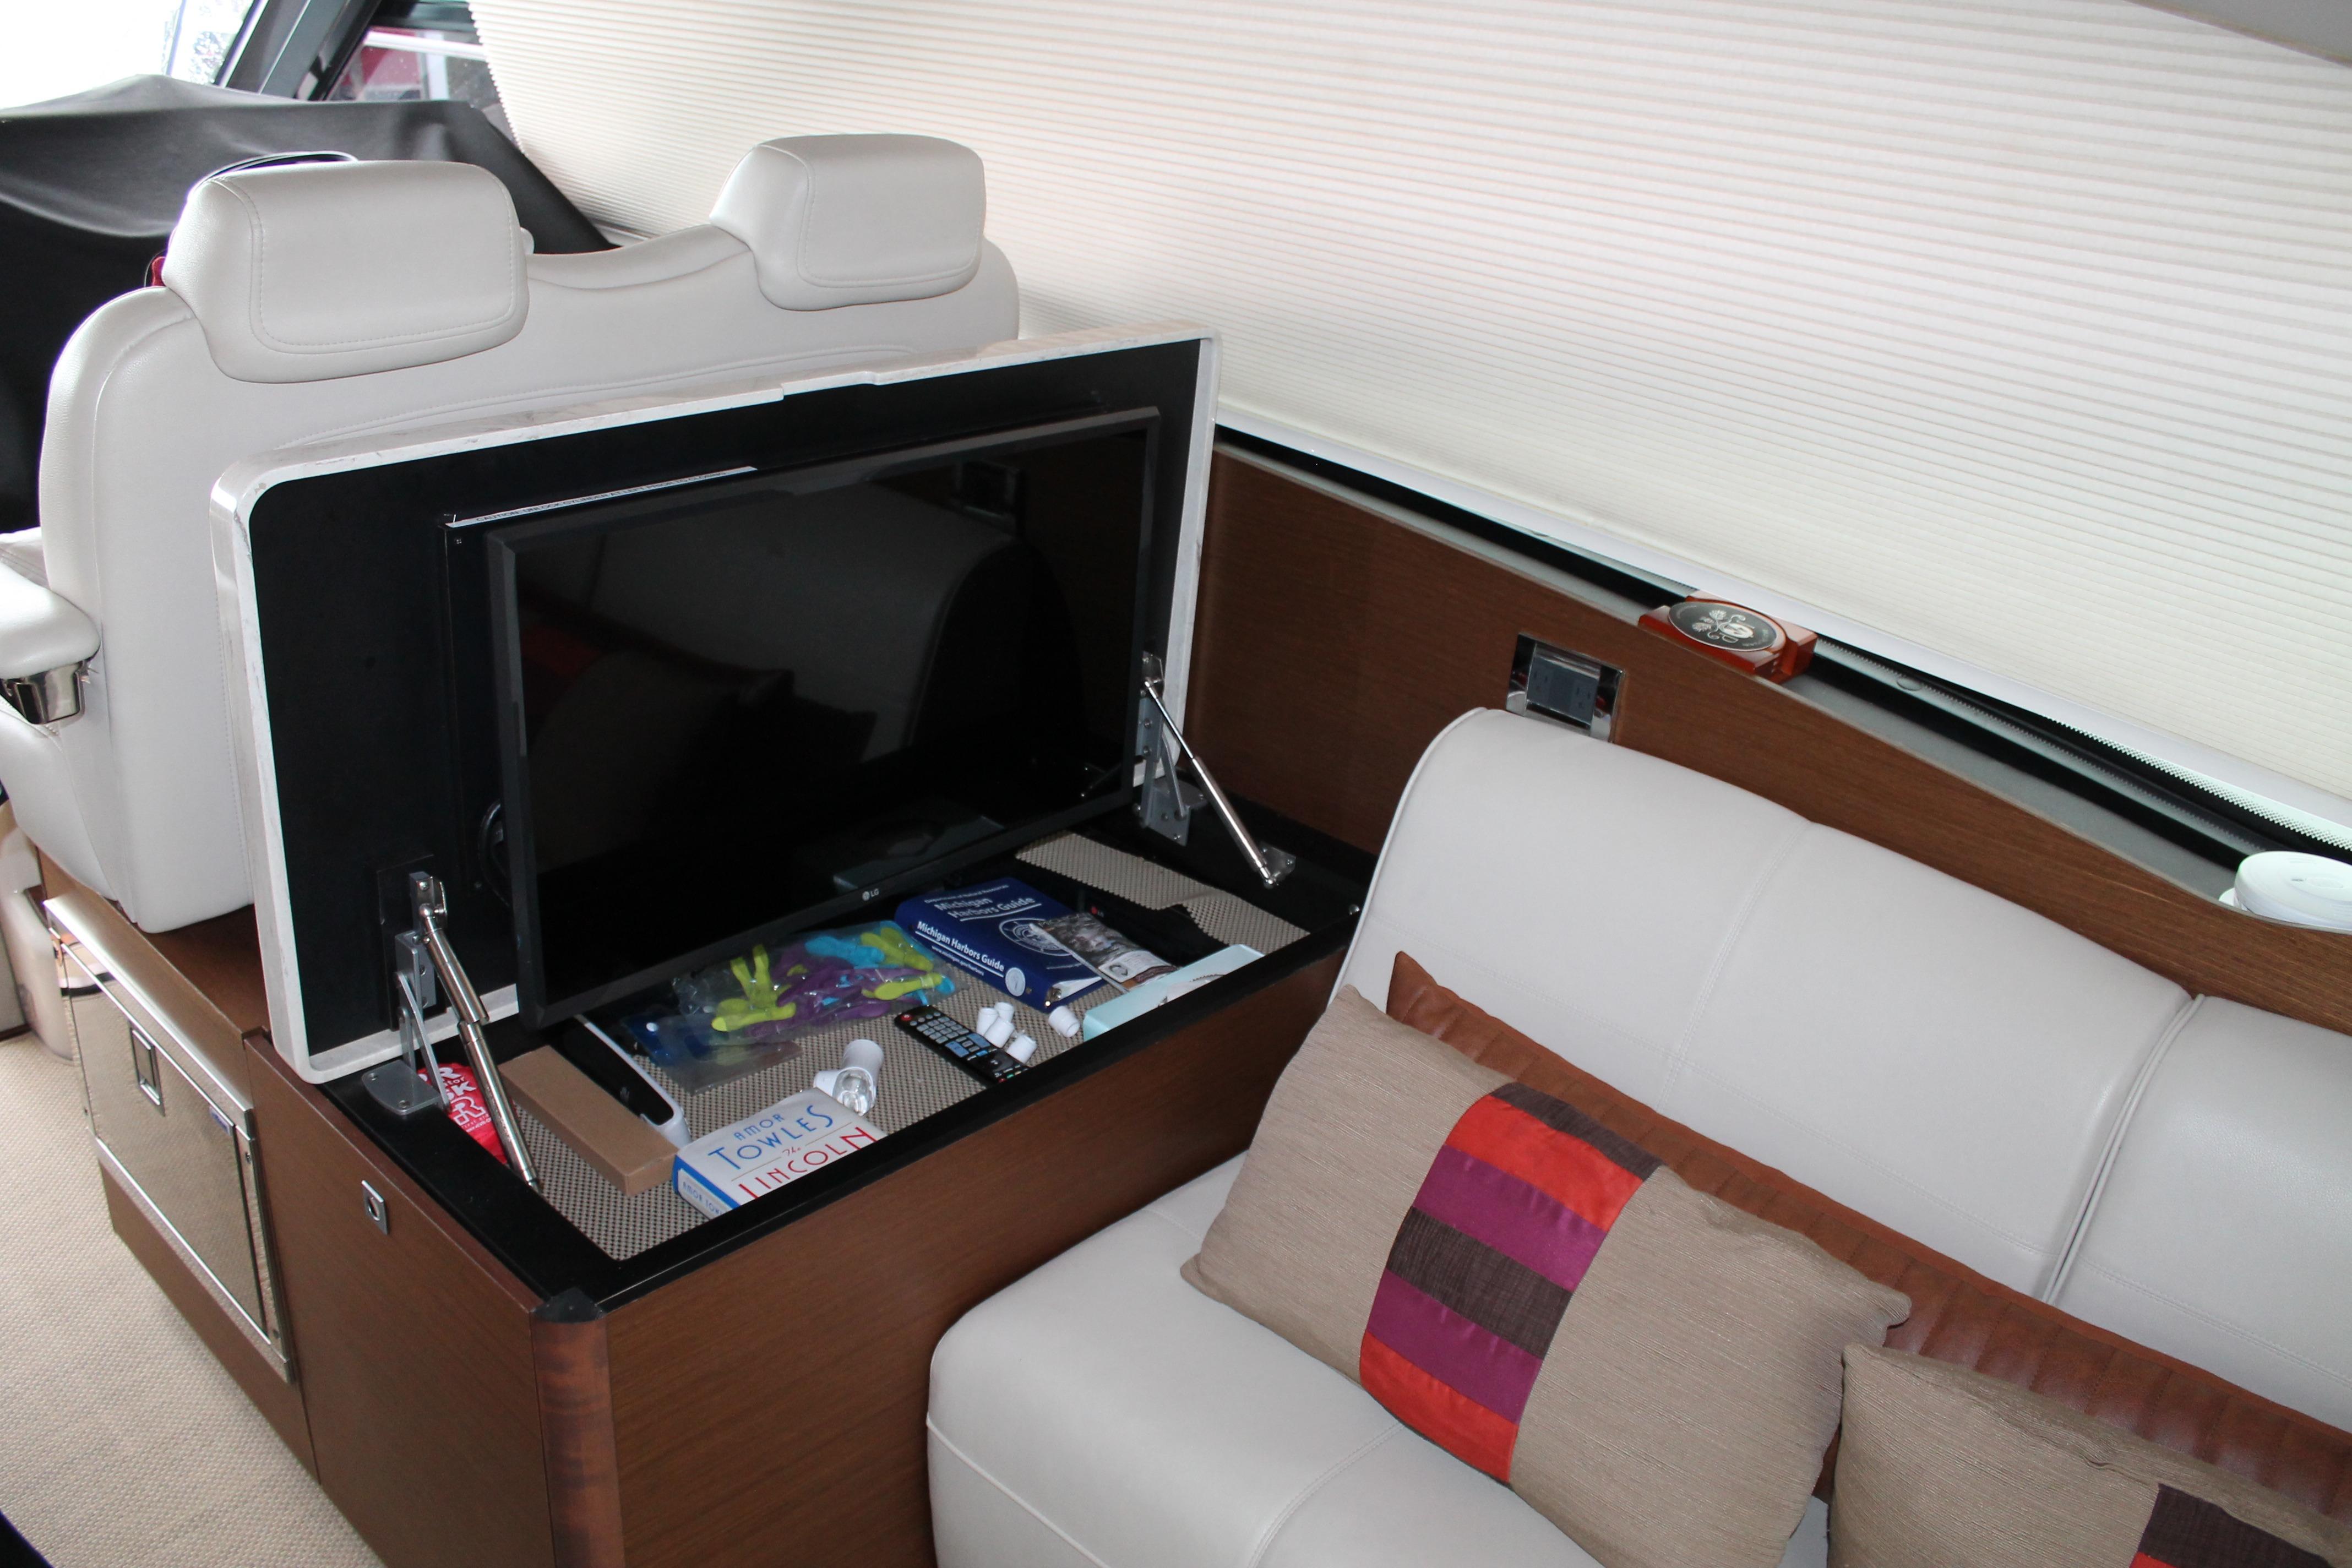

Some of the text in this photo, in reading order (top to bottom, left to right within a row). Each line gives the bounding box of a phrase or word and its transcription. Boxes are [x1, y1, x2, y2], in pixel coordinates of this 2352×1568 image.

[870, 888, 879, 897] LG
[934, 897, 993, 910] Michigan
[948, 897, 1036, 918] Harbors Guide
[917, 921, 1005, 972] Michigan Harbors Guide
[708, 1105, 833, 1170] TOWLES
[734, 1113, 785, 1141] AMOR
[738, 1126, 879, 1200] LINCOLN
[782, 1146, 802, 1157] The
